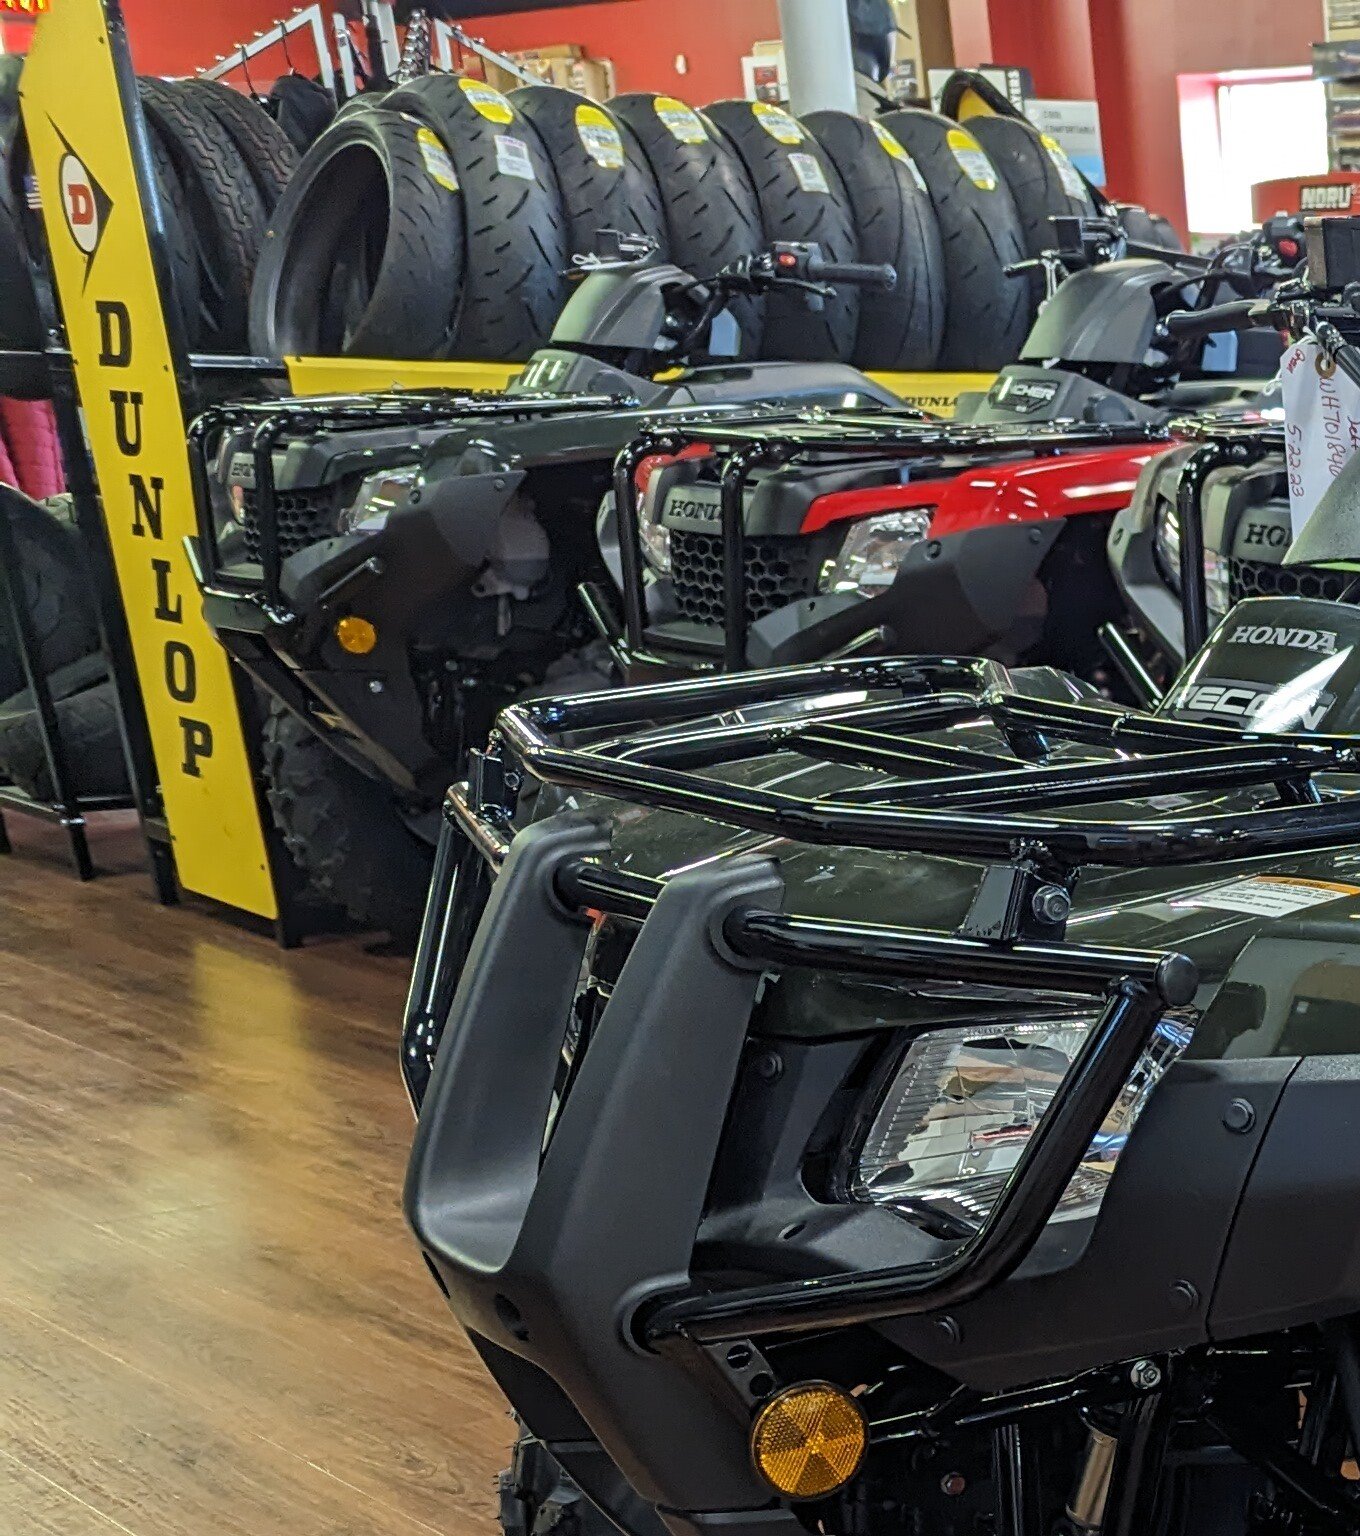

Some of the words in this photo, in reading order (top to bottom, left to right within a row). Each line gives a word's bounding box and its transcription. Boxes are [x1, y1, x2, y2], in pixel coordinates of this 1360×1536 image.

[68, 184, 94, 225] D
[1301, 185, 1351, 210] NORU
[95, 301, 213, 777] DUNLOP
[1244, 522, 1292, 547] HO
[1227, 625, 1339, 656] HONDA
